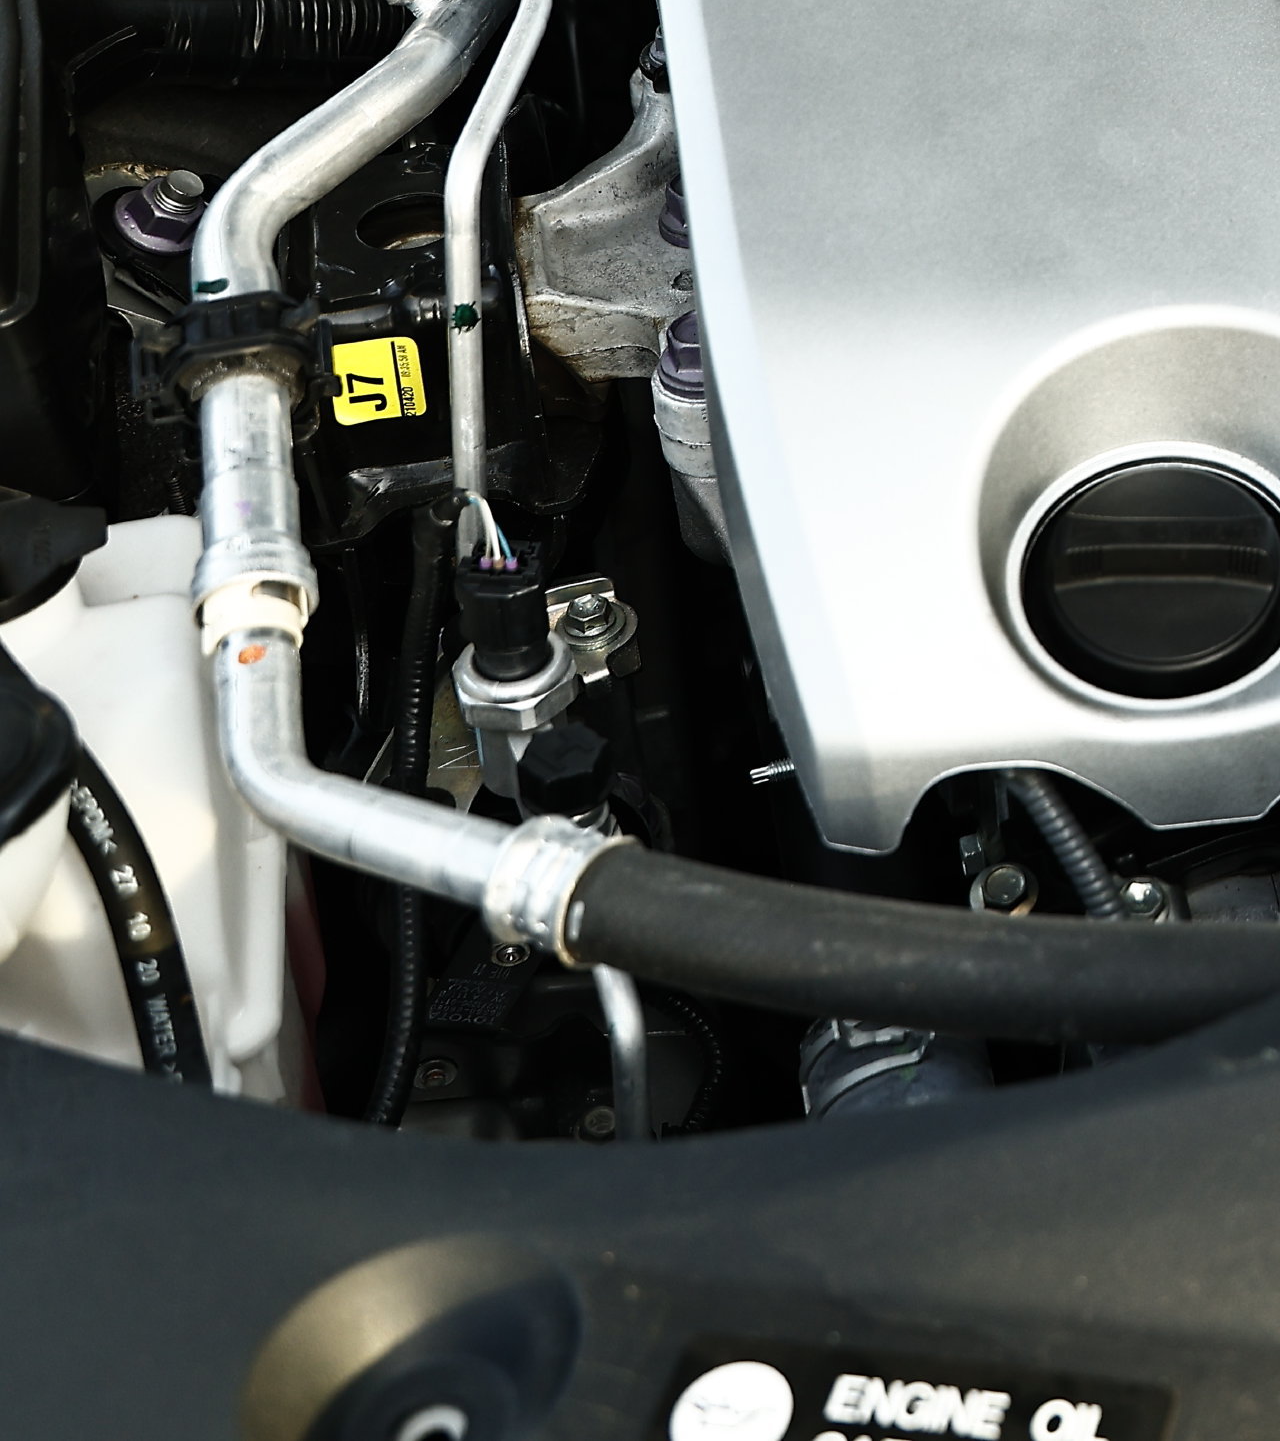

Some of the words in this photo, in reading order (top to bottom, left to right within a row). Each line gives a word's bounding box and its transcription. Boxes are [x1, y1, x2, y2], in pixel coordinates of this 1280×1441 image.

[346, 373, 387, 412] J7
[401, 386, 416, 417] 210420
[110, 863, 139, 897] 27
[136, 958, 160, 985] 20
[147, 992, 177, 1058] WATER
[823, 1373, 1012, 1441] ENGINE
[1029, 1398, 1110, 1441] OIL
